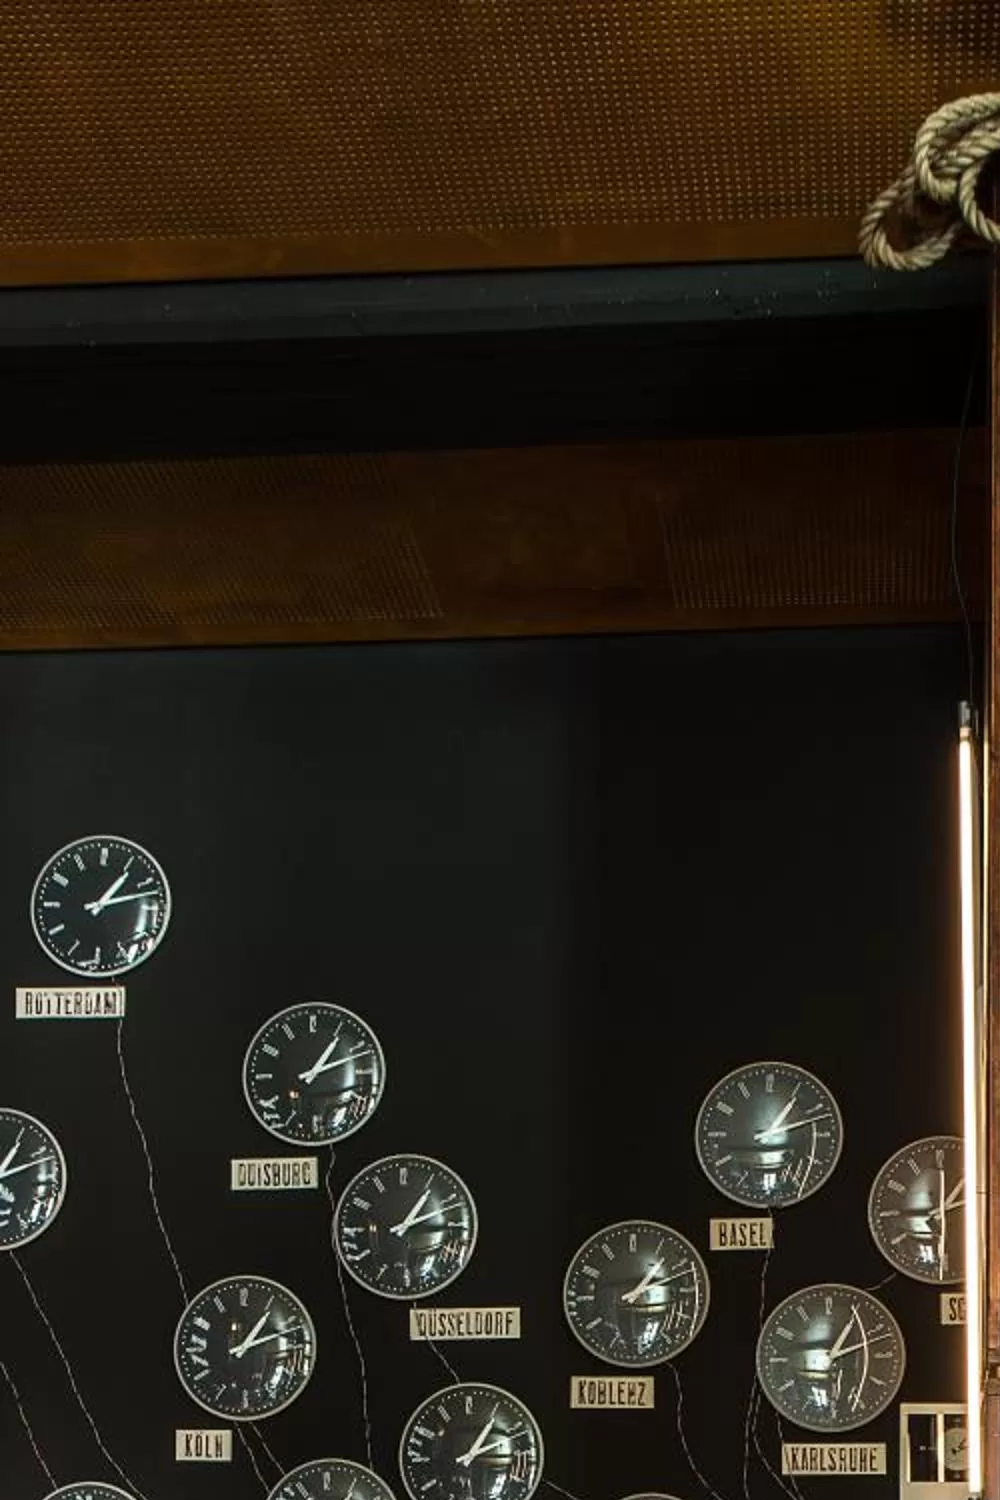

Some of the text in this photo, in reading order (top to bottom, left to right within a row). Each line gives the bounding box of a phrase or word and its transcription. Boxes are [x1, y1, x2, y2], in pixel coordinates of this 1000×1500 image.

[25, 991, 117, 1017] ROTTERDAM
[238, 1161, 311, 1187] DUISBURG
[719, 1221, 767, 1247] BASEL
[418, 1310, 513, 1337] DÜSSELDORF
[578, 1380, 647, 1406] KOBLENZ
[791, 1446, 878, 1473] KARLSRUHE
